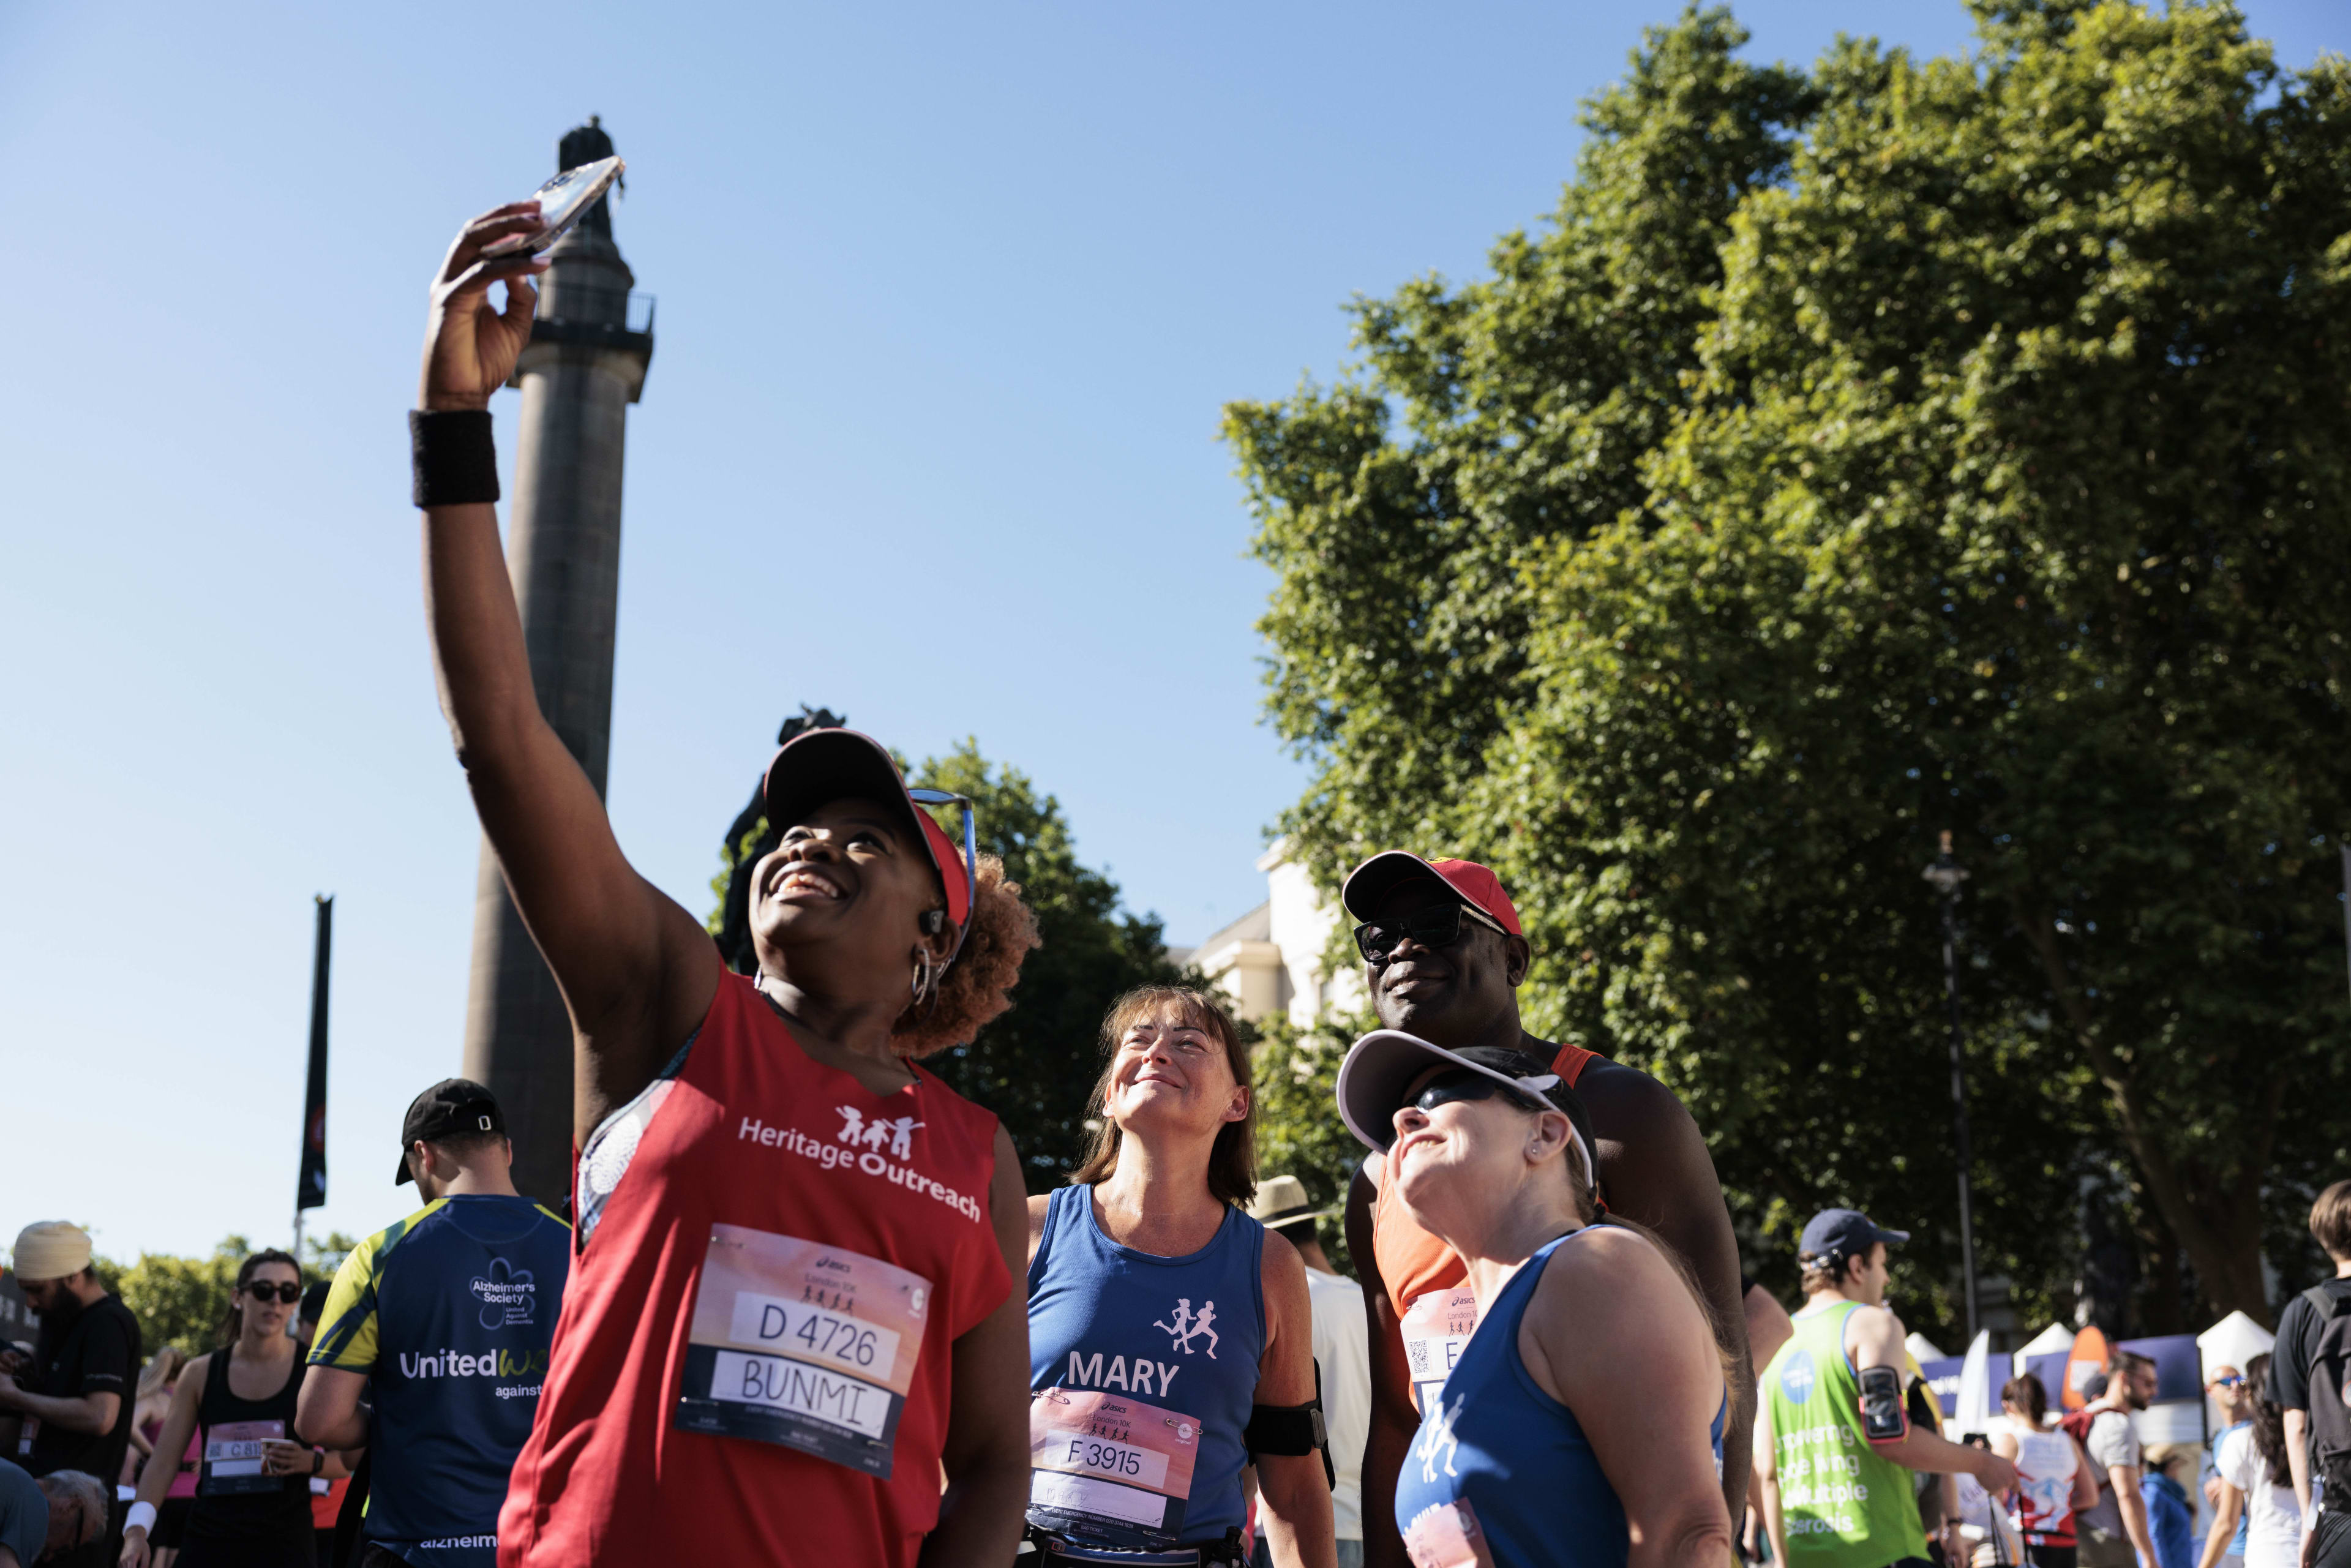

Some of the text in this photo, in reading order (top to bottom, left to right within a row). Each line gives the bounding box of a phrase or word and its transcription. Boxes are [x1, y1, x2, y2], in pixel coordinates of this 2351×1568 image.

[738, 1116, 981, 1223] Heritage Outreach
[473, 1281, 535, 1292] Alzheimer's
[484, 1292, 524, 1305] Society
[1447, 1311, 1471, 1320] London
[759, 1304, 877, 1366] D 4726
[1446, 1342, 1458, 1370] E
[1068, 1351, 1180, 1397] MARY
[495, 1384, 542, 1400] against
[742, 1360, 868, 1426] BUNMI
[1109, 1405, 1127, 1414] asics
[1093, 1414, 1131, 1428] London 10K
[231, 1442, 261, 1457] C 81
[1068, 1440, 1141, 1475] F 3915
[1063, 1510, 1087, 1518] EMERGENCY
[1088, 1514, 1105, 1523] NUMBER
[420, 1535, 500, 1548] alzheim
